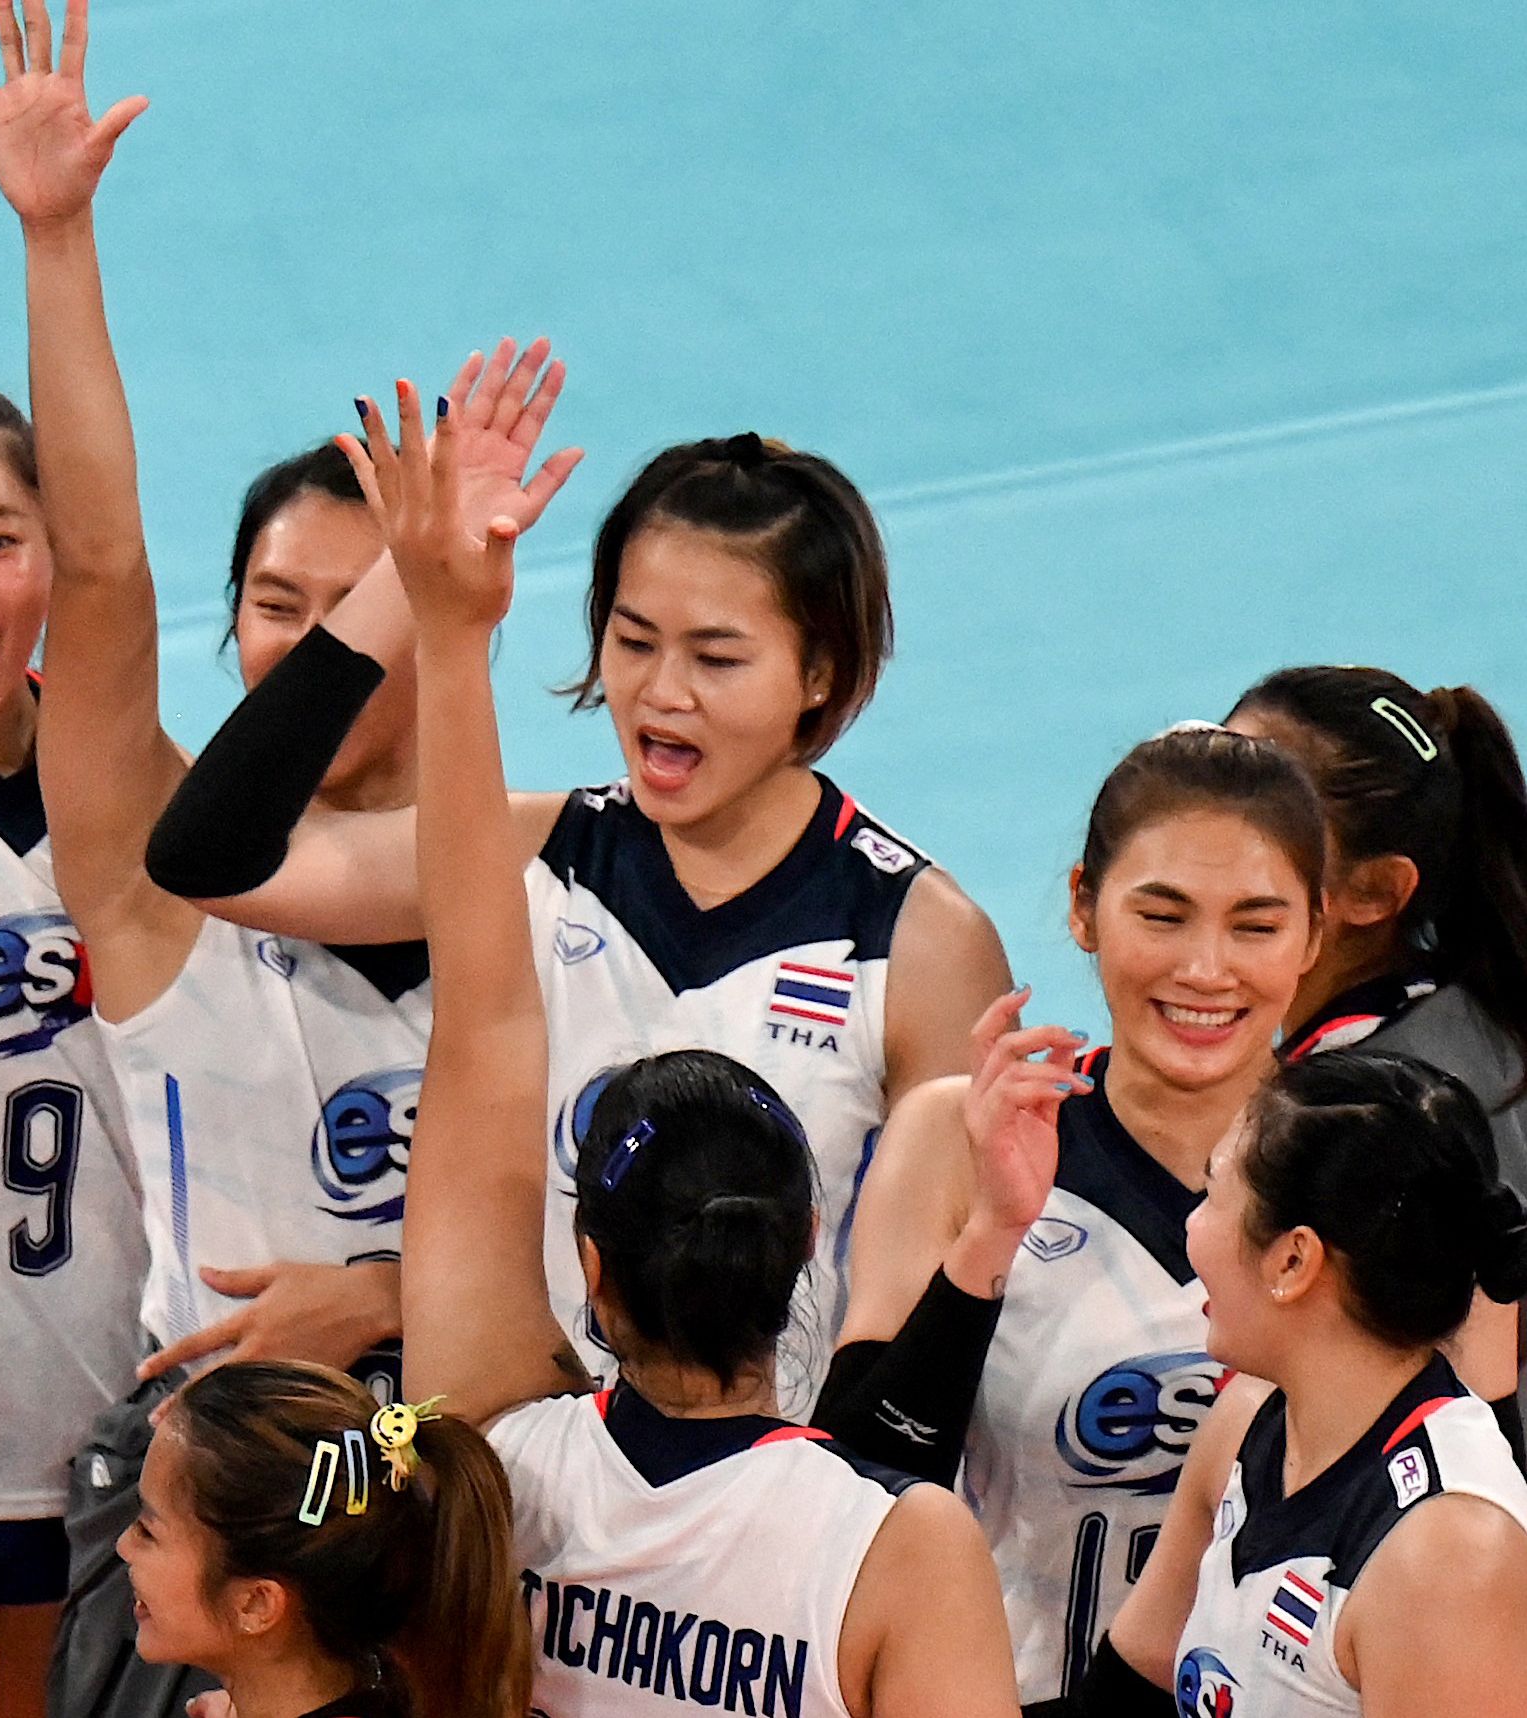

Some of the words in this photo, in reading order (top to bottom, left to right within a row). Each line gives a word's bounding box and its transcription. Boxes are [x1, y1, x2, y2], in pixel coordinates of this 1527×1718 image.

[766, 1022, 838, 1052] THA
[1397, 1454, 1421, 1500] PEA
[1261, 1630, 1306, 1673] THA
